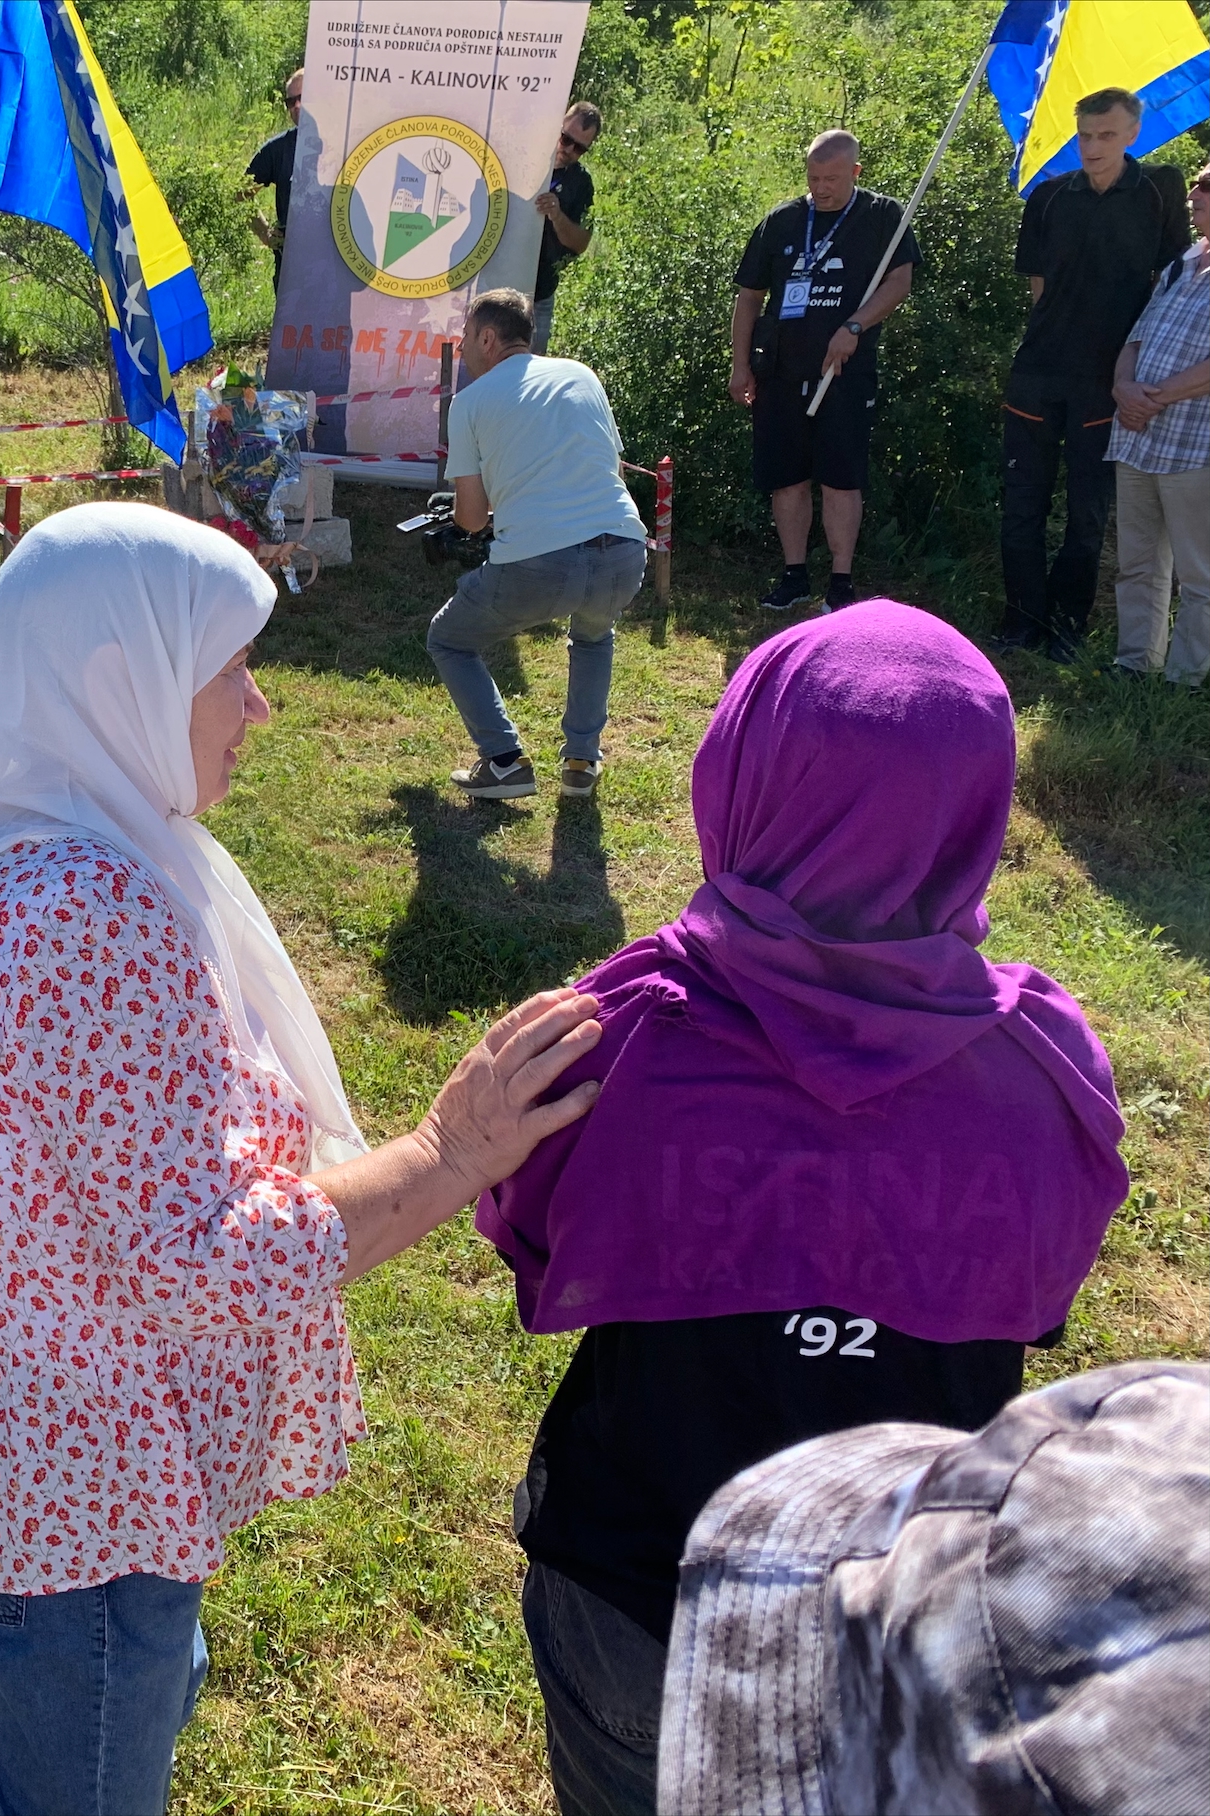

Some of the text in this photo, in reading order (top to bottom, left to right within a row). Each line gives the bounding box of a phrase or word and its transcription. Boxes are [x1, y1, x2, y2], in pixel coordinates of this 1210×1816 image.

[327, 21, 563, 44] UDRUŽENJE ČLANOVA PORODICA NESTALIH
[328, 37, 558, 58] OSOBA SA PODRUČJA OPŠTINE KALINOVIK
[326, 64, 392, 83] "ISTINA
[410, 69, 510, 91] KALINOVIK
[516, 76, 552, 92] '92"
[385, 122, 438, 139] ČLANOVA
[440, 124, 489, 166] PORODICA
[339, 134, 385, 195] UDRUŽENJE
[486, 163, 503, 219] NESTALIH
[336, 205, 359, 263] KALINOVIK
[474, 222, 499, 260] OSOBA
[356, 261, 399, 291] OPŠTINE
[461, 260, 477, 273] SA
[402, 270, 462, 294] PODRUČJA
[811, 285, 843, 294] se ne
[320, 325, 350, 351] SE
[355, 327, 388, 356] NE
